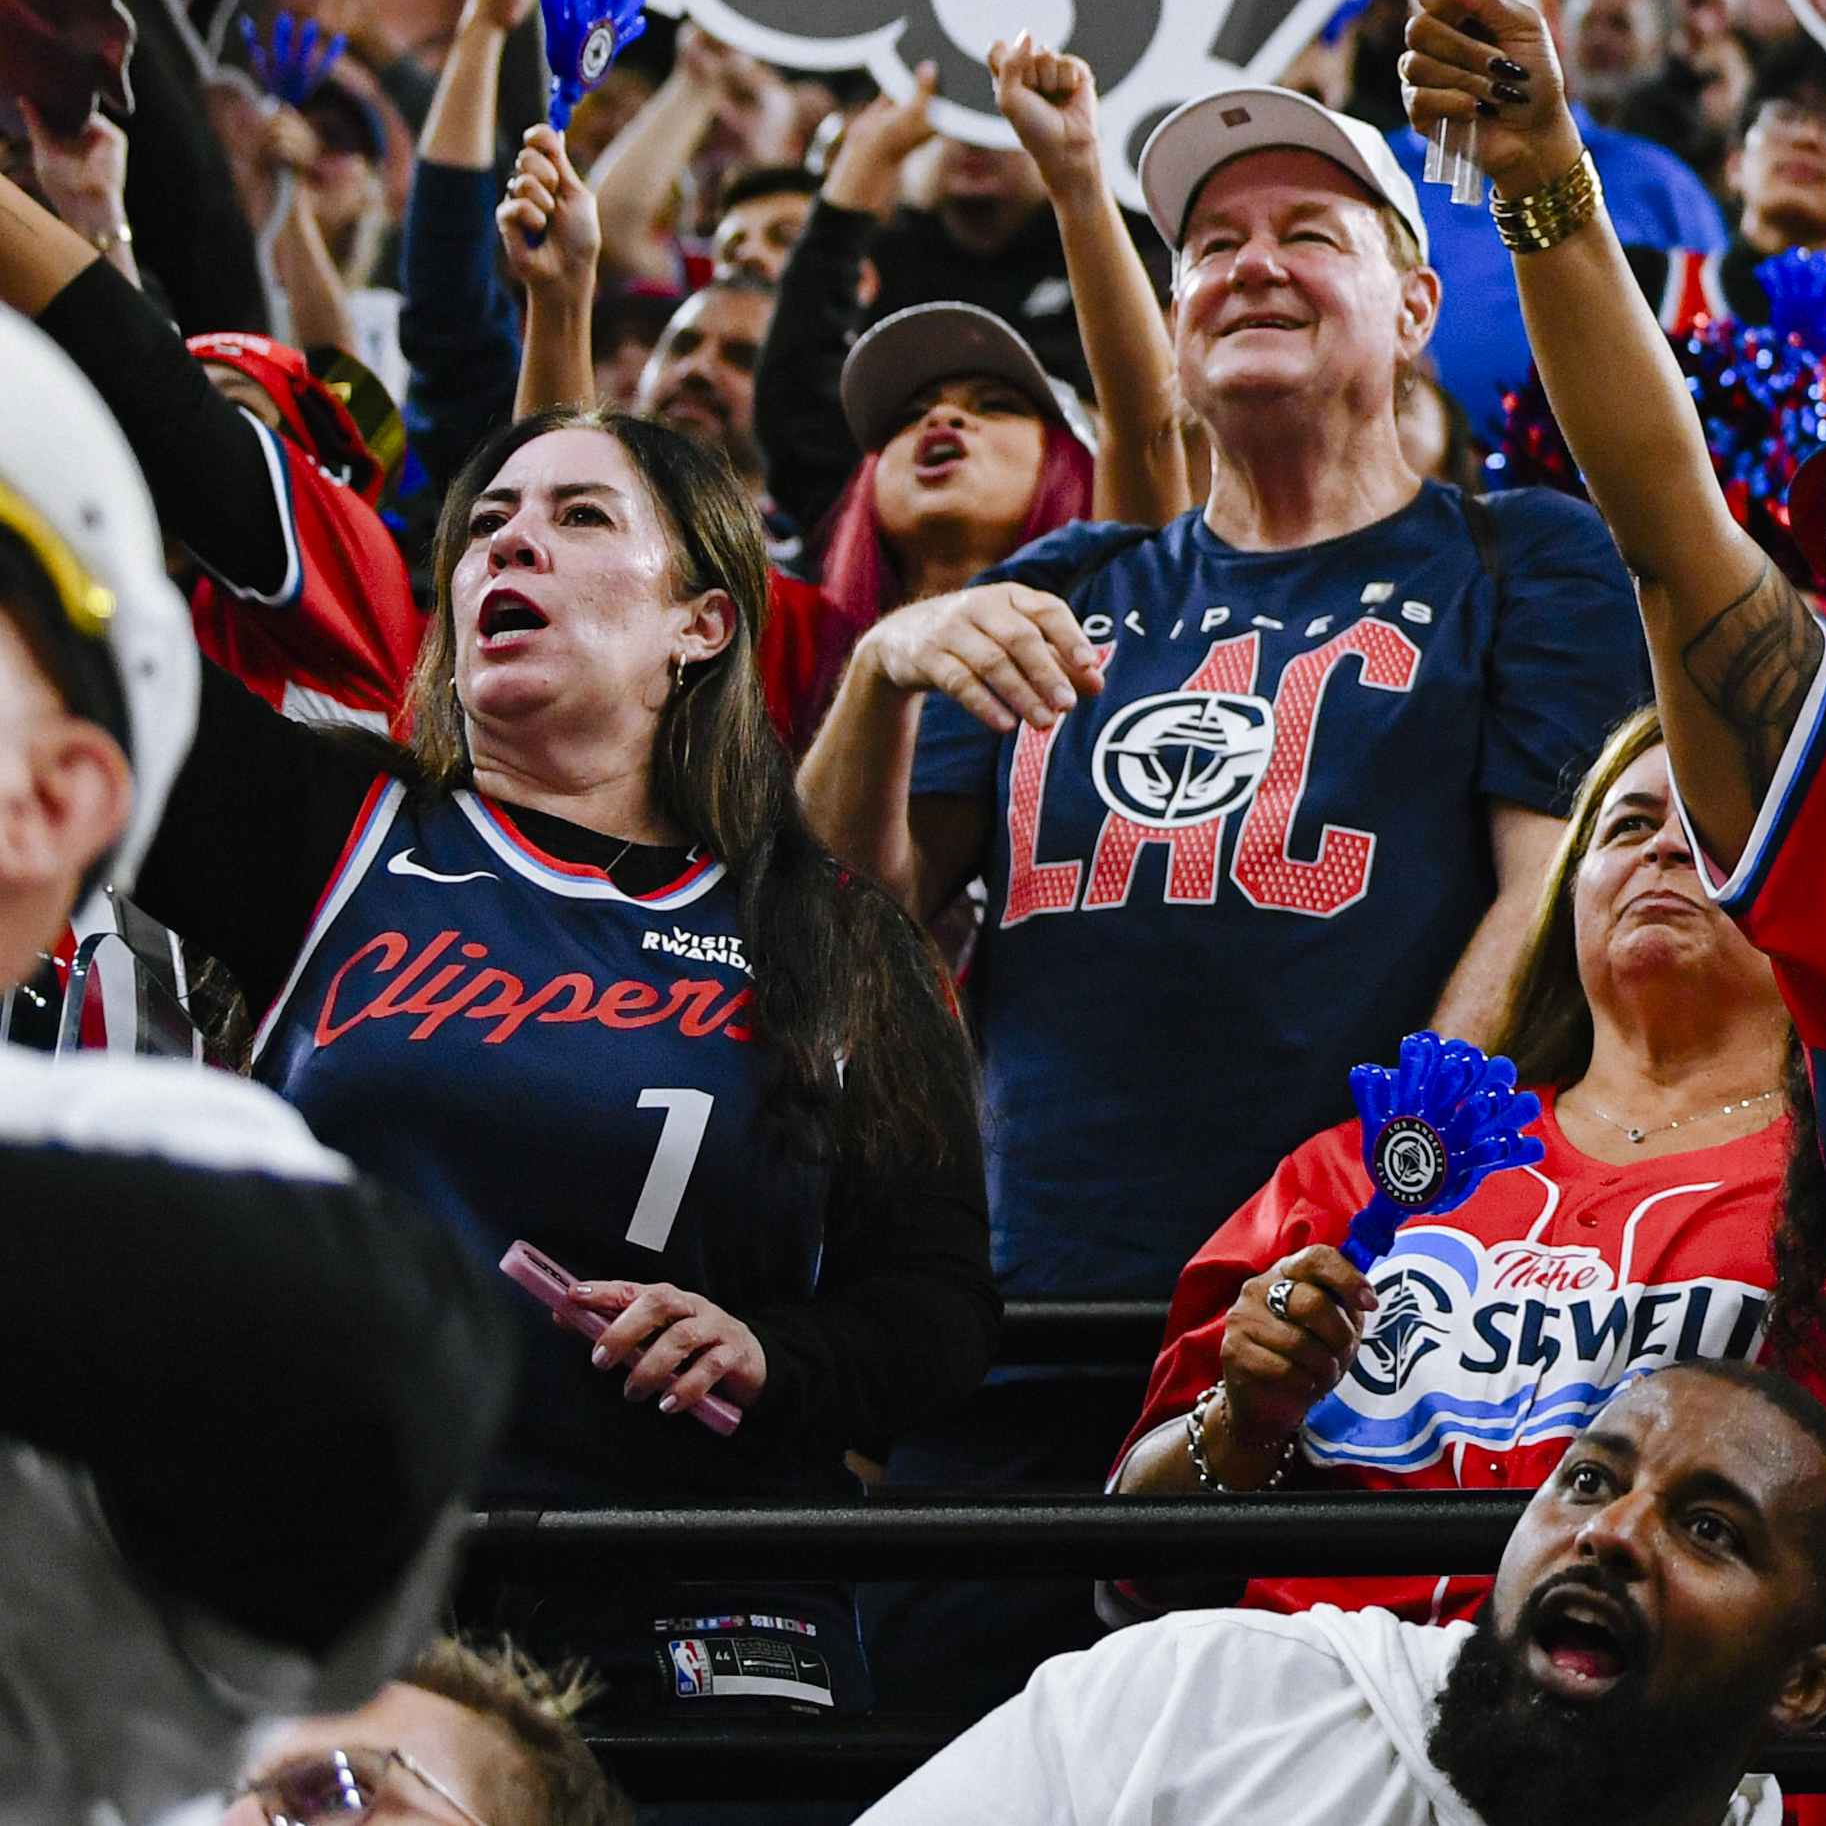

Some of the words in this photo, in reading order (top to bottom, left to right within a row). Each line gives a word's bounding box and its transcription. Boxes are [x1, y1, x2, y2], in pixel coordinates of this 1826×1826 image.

[1000, 617, 1422, 929] LAC
[672, 925, 743, 953] VISIT
[624, 1087, 715, 1253] 1
[715, 1650, 731, 1661] 44
